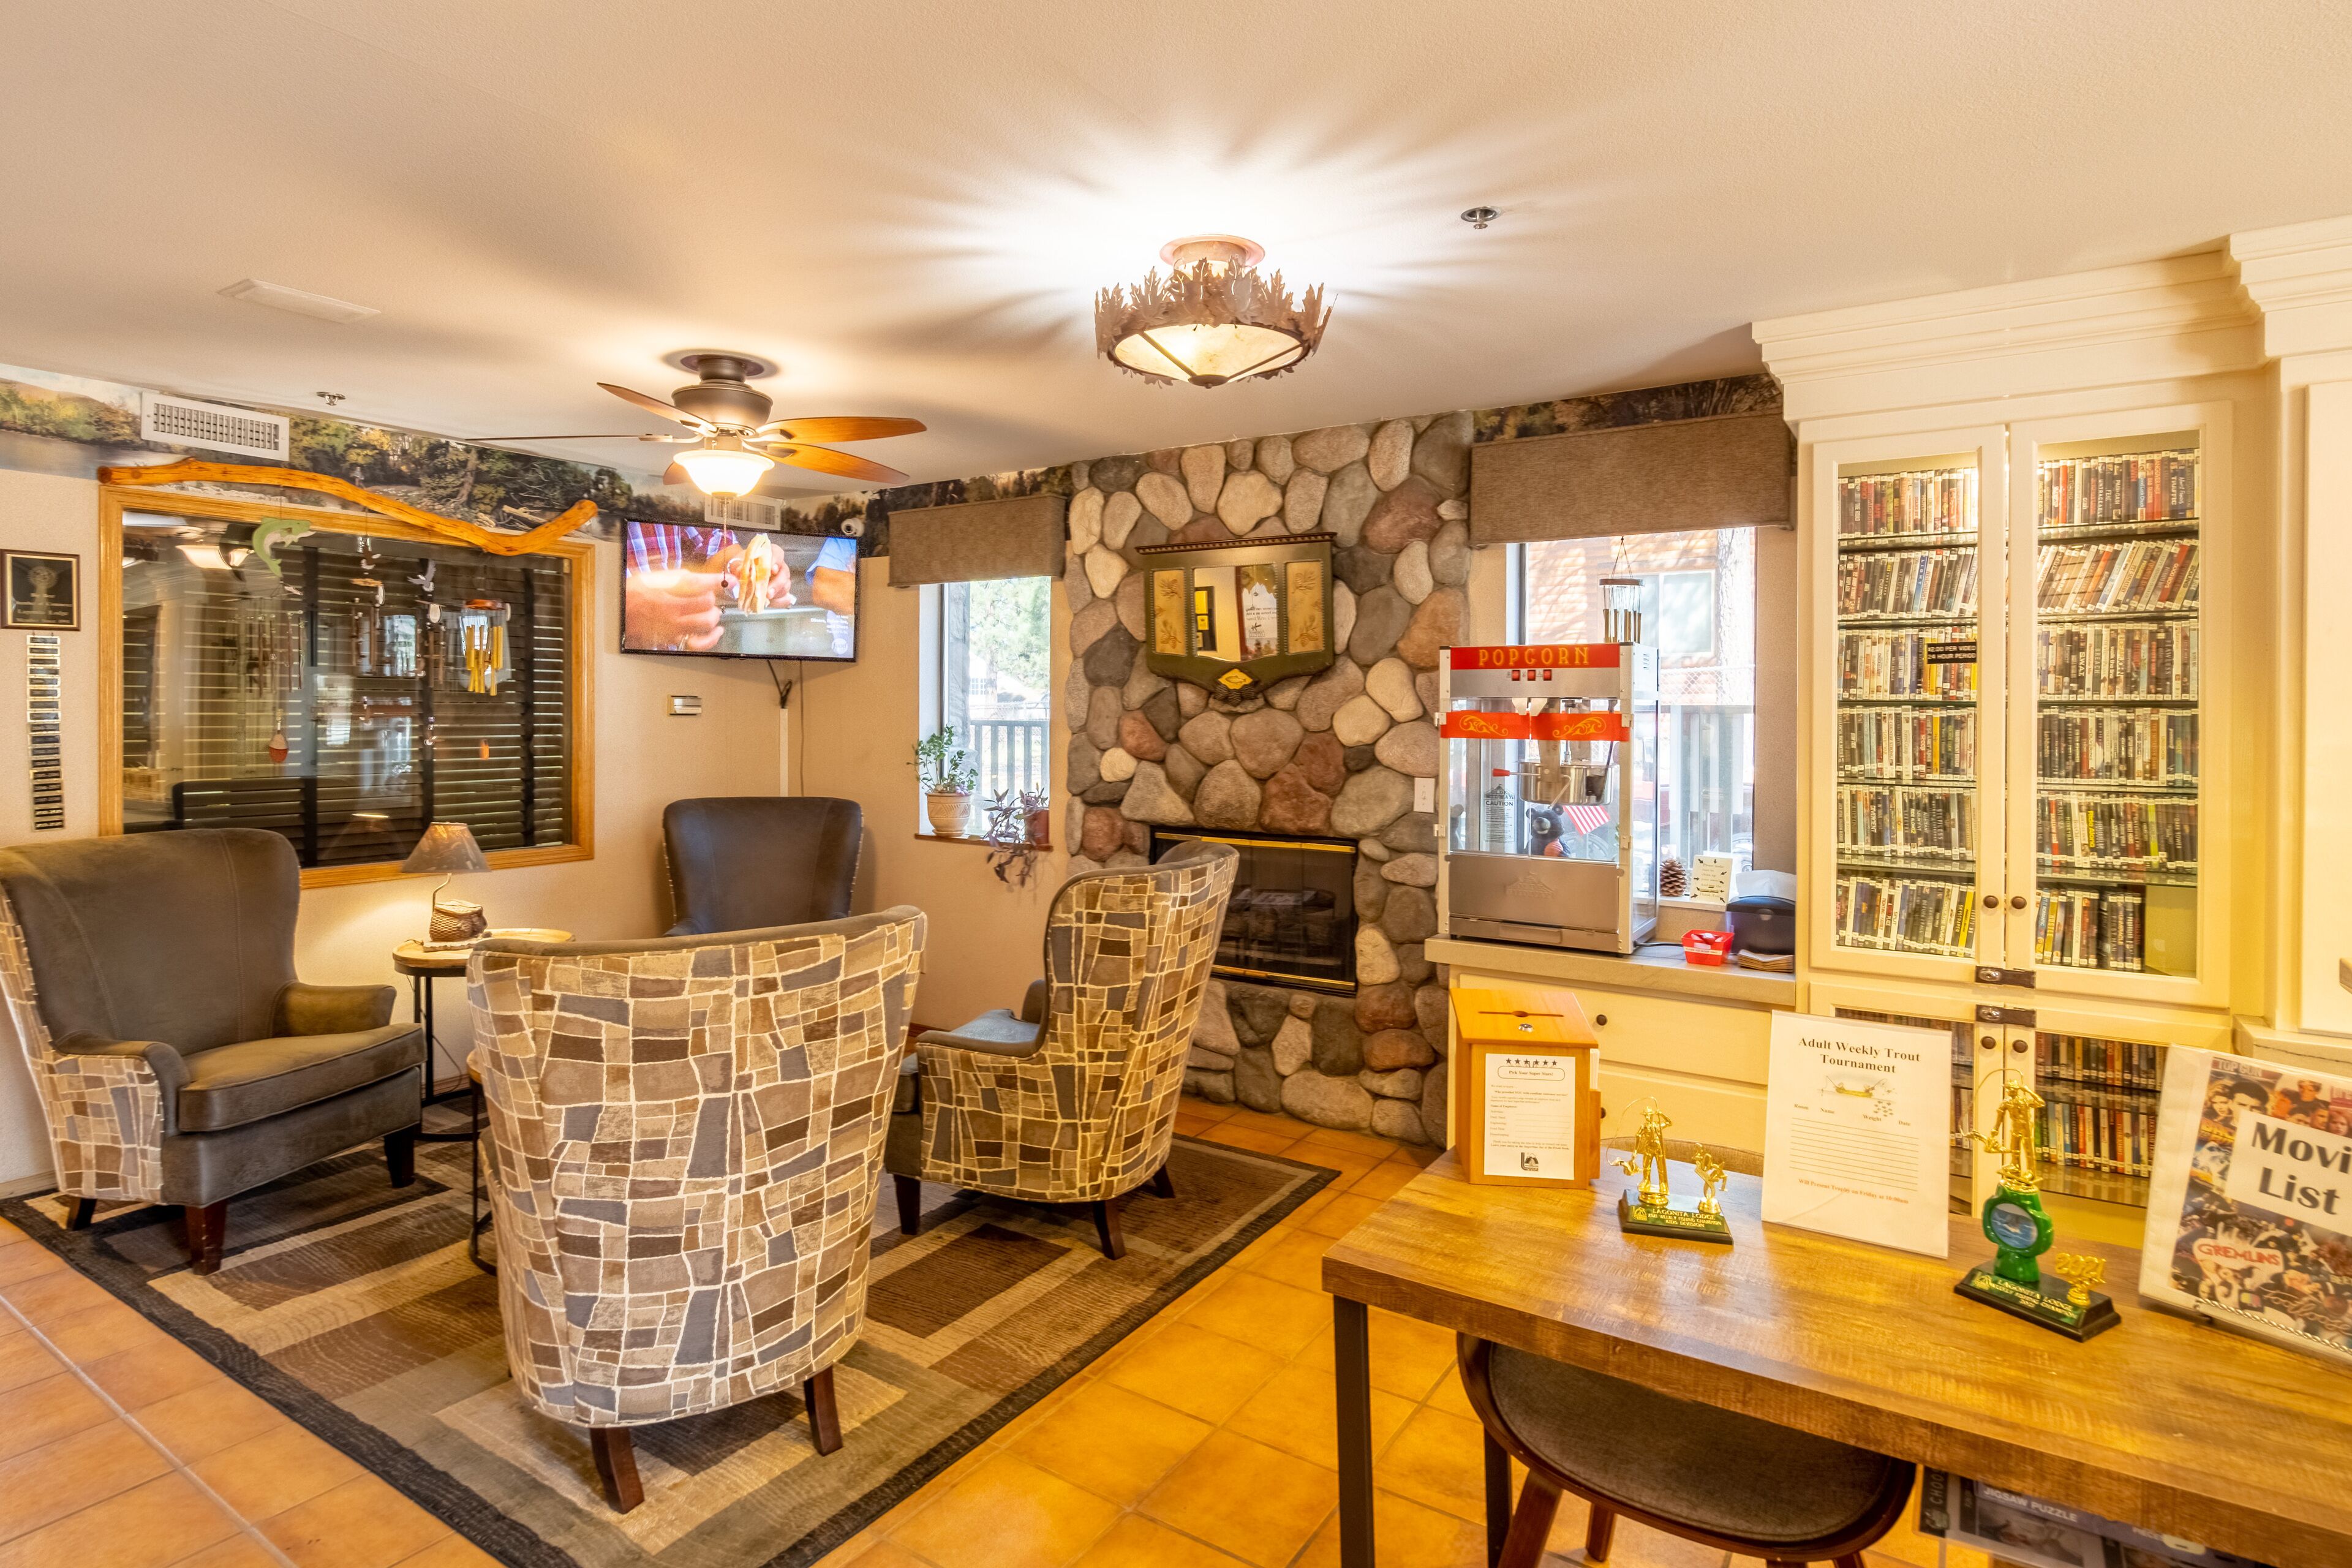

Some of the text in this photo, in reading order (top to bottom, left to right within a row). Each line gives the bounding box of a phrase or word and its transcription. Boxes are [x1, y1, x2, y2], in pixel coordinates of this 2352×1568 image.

[1479, 646, 1589, 666] POPCORN
[1798, 1037, 1921, 1062] Adult Weekly Trout
[1820, 1054, 1896, 1073] Tournament
[1811, 1181, 1830, 1189] Present
[1831, 1185, 1850, 1194] Trophy
[2258, 1166, 2340, 1216] List
[1653, 1208, 1689, 1217] LAGONITA
[2055, 1252, 2106, 1280] 2021
[2197, 1242, 2281, 1267] GREMLINS
[1997, 1279, 2073, 1311] LAGONITA LODGE
[1929, 1470, 1945, 1505] CHOO
[1983, 1487, 2028, 1507] JIGSAW
[2030, 1501, 2077, 1523] PUZZLE
